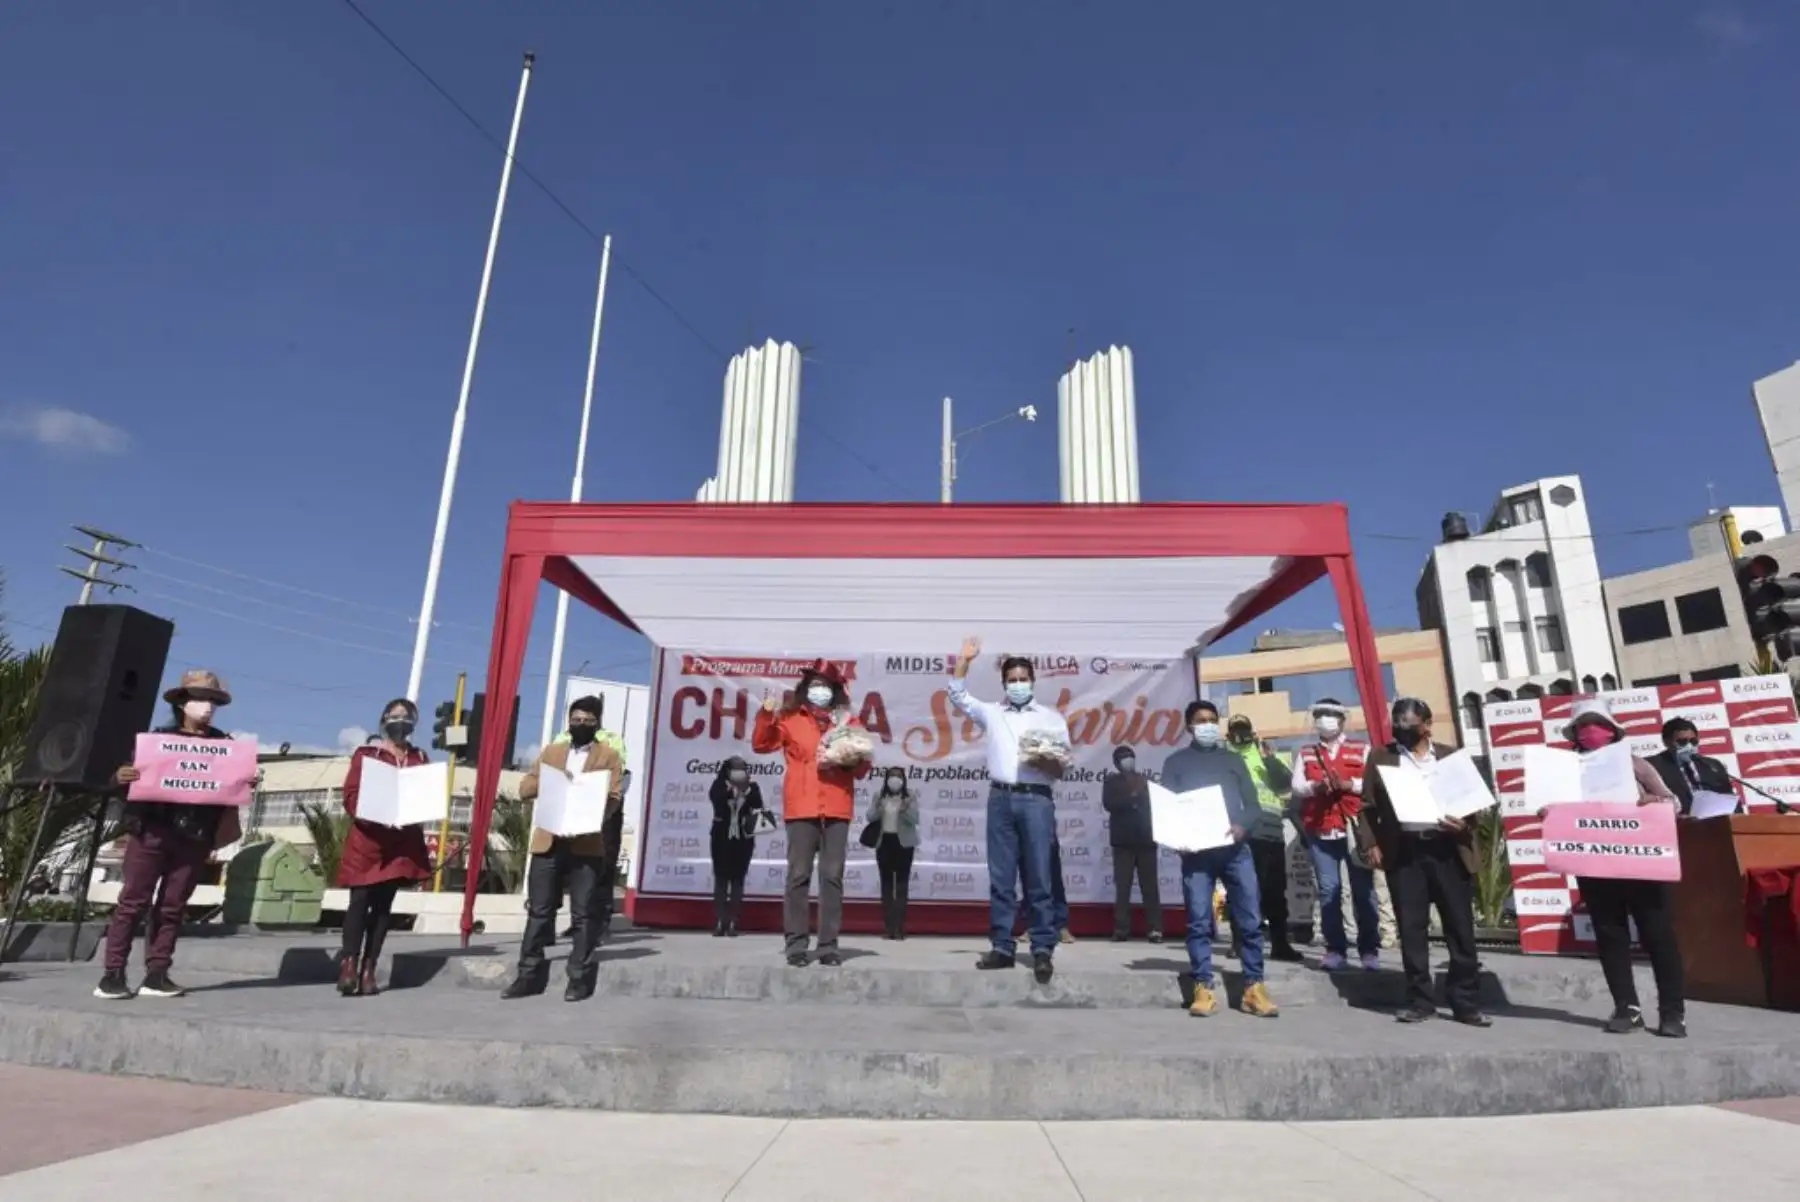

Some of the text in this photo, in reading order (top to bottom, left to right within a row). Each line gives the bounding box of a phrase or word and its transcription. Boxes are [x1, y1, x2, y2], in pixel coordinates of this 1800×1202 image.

[691, 658, 766, 676] Programa
[886, 656, 943, 672] MIDIS
[162, 743, 228, 757] MIRADOR
[180, 761, 208, 772] SAN
[908, 765, 922, 780] la
[163, 779, 218, 790] MIGUEL
[1578, 818, 1640, 830] BARRIO
